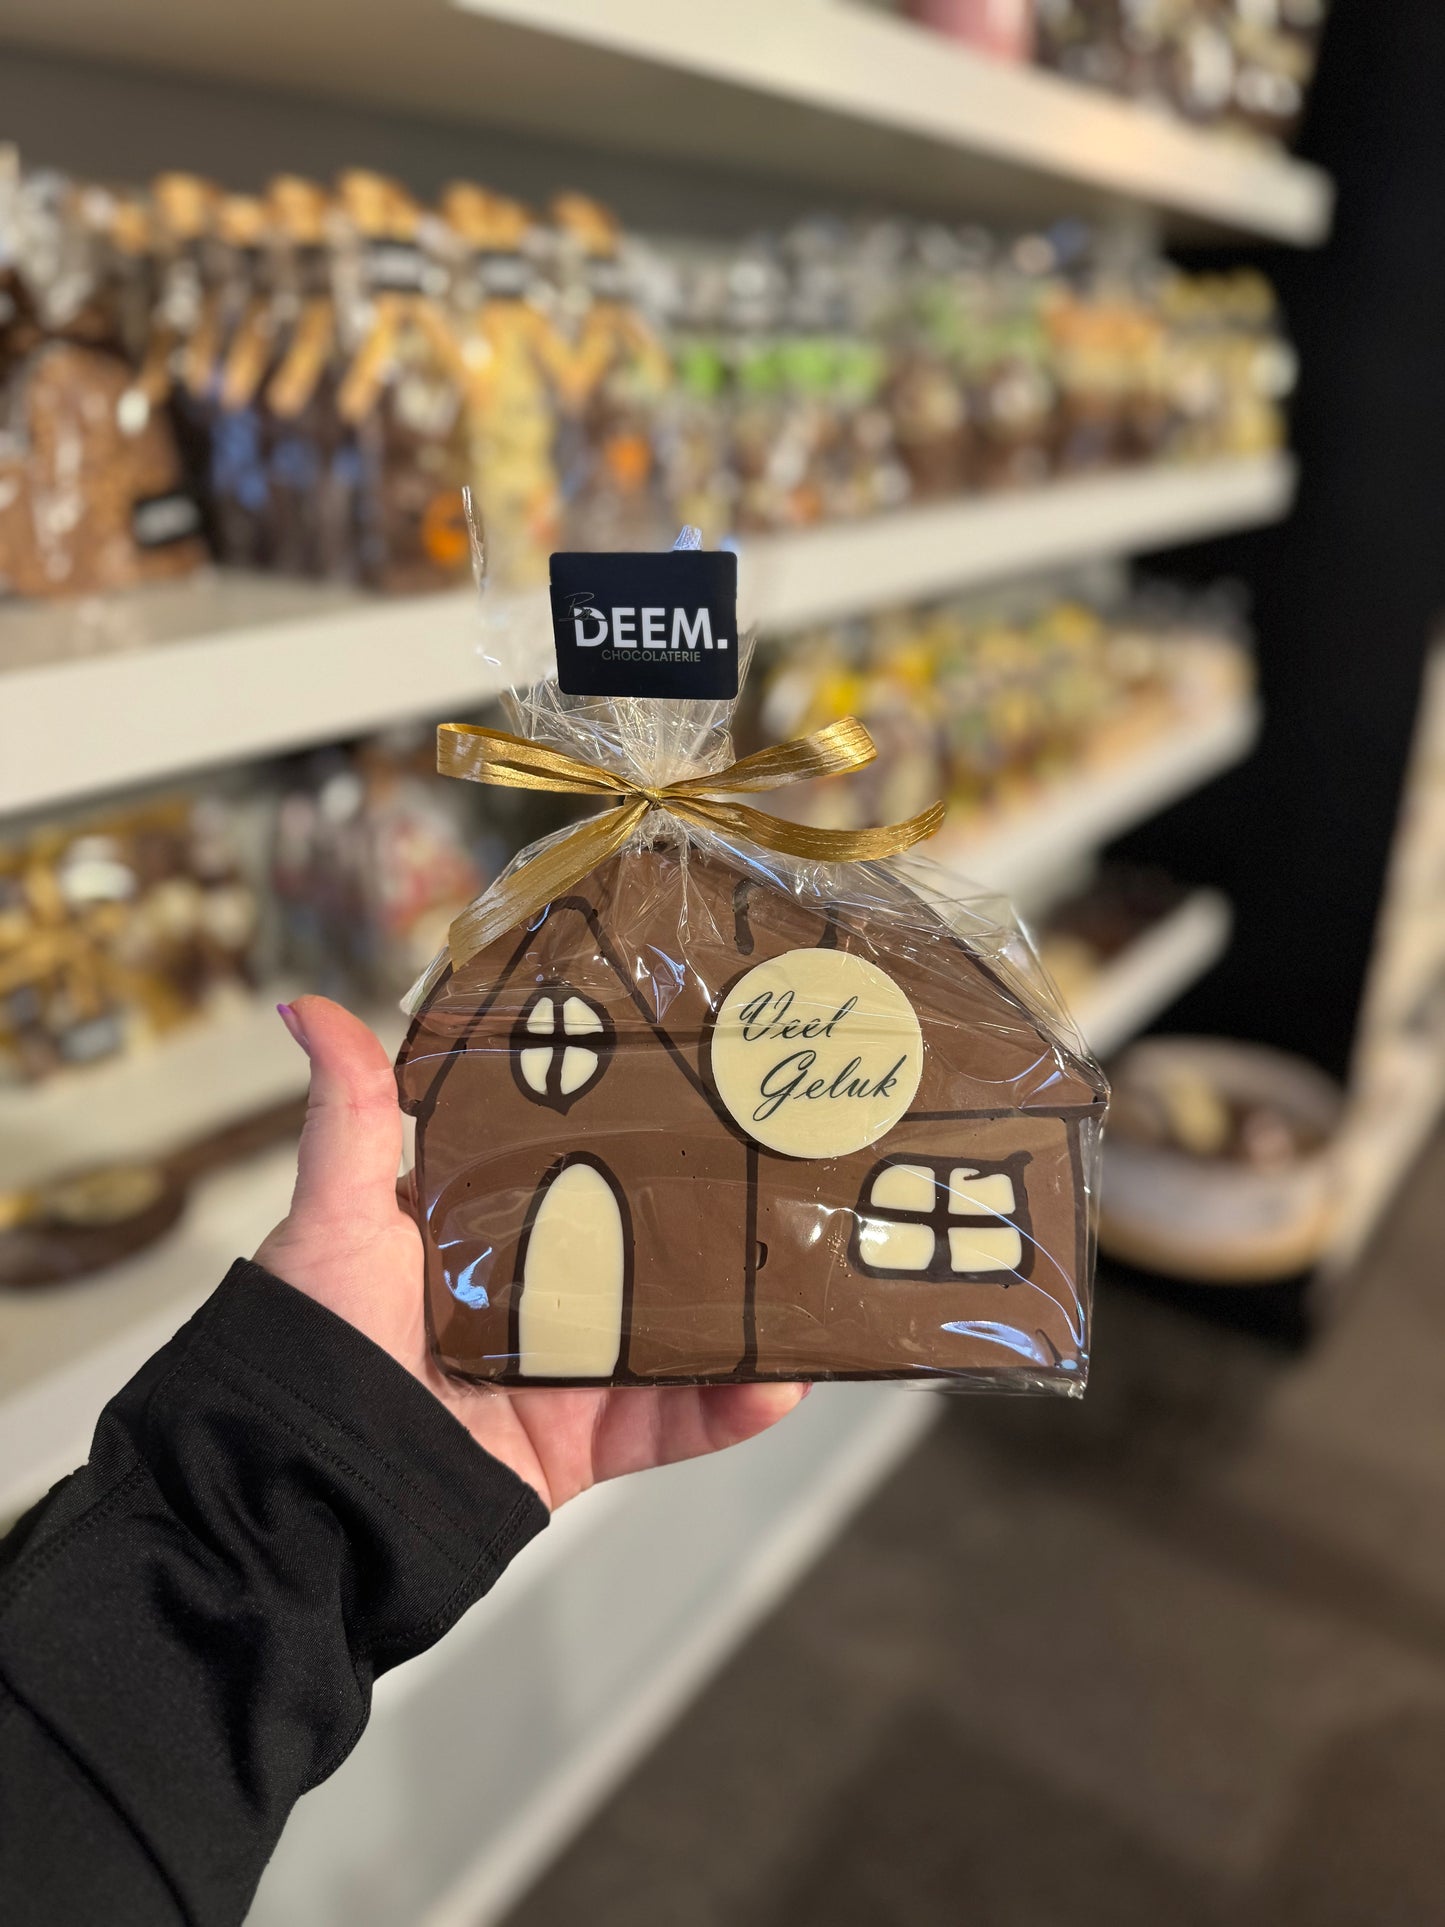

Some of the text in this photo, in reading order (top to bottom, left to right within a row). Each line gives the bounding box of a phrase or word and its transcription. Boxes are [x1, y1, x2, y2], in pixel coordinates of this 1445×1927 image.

[574, 607, 728, 649] DEEM.
[602, 650, 701, 662] CHOCOLATERIE
[739, 990, 858, 1039] Veel
[752, 1050, 907, 1122] Geluk
